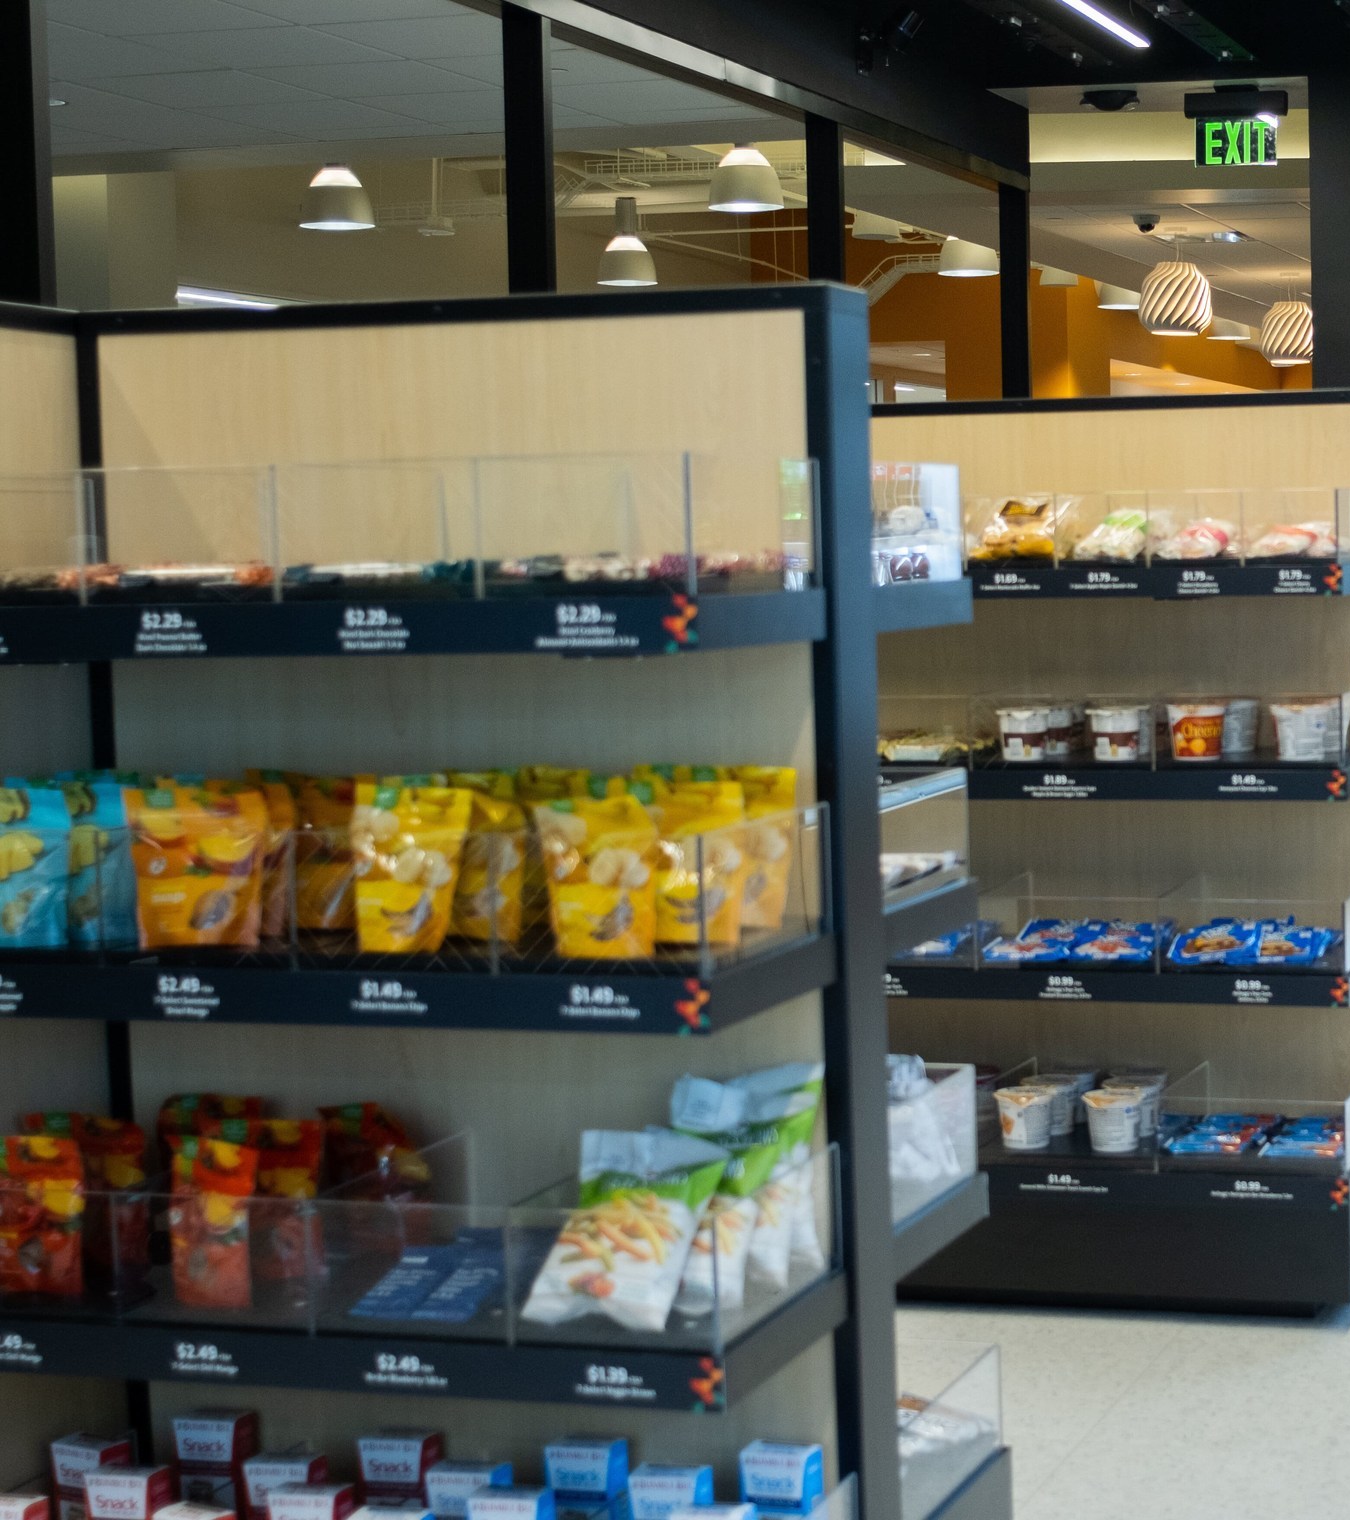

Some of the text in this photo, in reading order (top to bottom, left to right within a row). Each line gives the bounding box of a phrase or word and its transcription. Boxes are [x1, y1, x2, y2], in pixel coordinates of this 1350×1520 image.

[1205, 122, 1269, 165] EXIT
[142, 611, 183, 630] $2.29
[344, 607, 388, 628] $2.29
[555, 603, 601, 625] $2.29
[157, 975, 201, 995] $2.49
[361, 978, 403, 1000] $1.49
[570, 983, 615, 1006] $1.49
[176, 1342, 218, 1361] $2.49
[376, 1353, 420, 1373] $2.49
[183, 1437, 225, 1452] Snack
[369, 1458, 412, 1473] Snack
[95, 1494, 138, 1510] Snack
